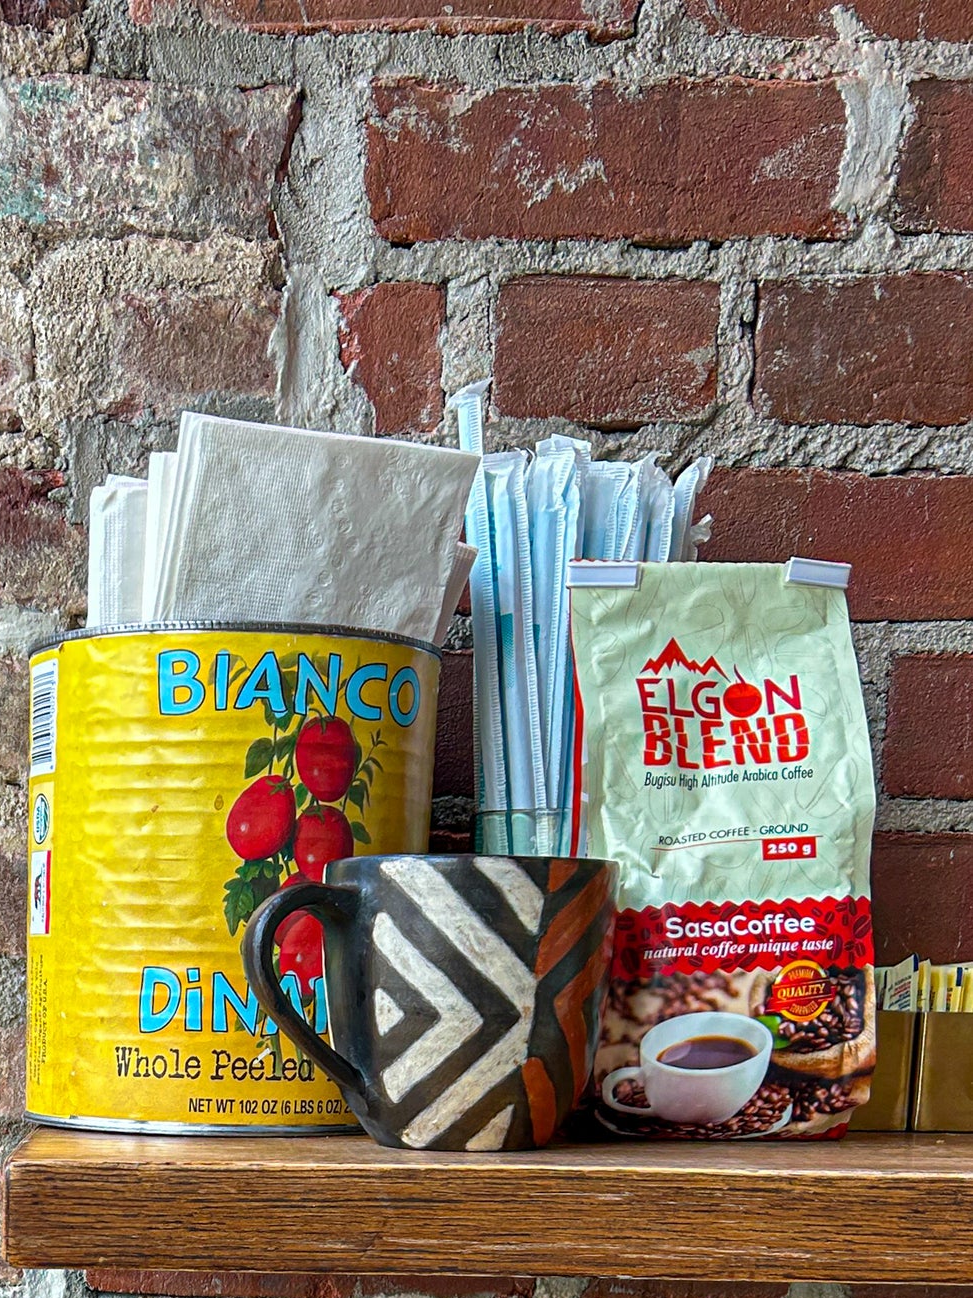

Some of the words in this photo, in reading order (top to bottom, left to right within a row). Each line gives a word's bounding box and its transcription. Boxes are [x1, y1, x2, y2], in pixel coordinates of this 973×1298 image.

[157, 648, 421, 728] BIANCO
[635, 674, 803, 719] ELGON
[642, 713, 810, 770] BLEND
[644, 771, 677, 790] Bugisu
[679, 773, 698, 791] High
[701, 769, 739, 788] Altitude
[742, 768, 778, 782] Arabica
[781, 765, 814, 780] Coffee
[658, 832, 707, 846] ROASTED
[709, 826, 750, 840] COFFEE
[759, 823, 809, 835] GROUND
[767, 842, 798, 855] 250
[802, 843, 812, 855] g
[665, 913, 816, 939] SasaCoffee
[643, 943, 698, 960] natural
[701, 940, 746, 958] coffee
[748, 939, 799, 955] unique
[802, 938, 834, 951] taste
[777, 983, 826, 1001] QUALITY
[114, 1046, 201, 1079] Whole
[188, 1098, 213, 1113] NET
[216, 1099, 236, 1114] WT
[239, 1099, 258, 1115] 102
[261, 1099, 278, 1115] OZ
[280, 1099, 291, 1116] (6
[294, 1099, 315, 1115] LBS
[316, 1099, 323, 1115] 6
[327, 1099, 343, 1116] OZ)
